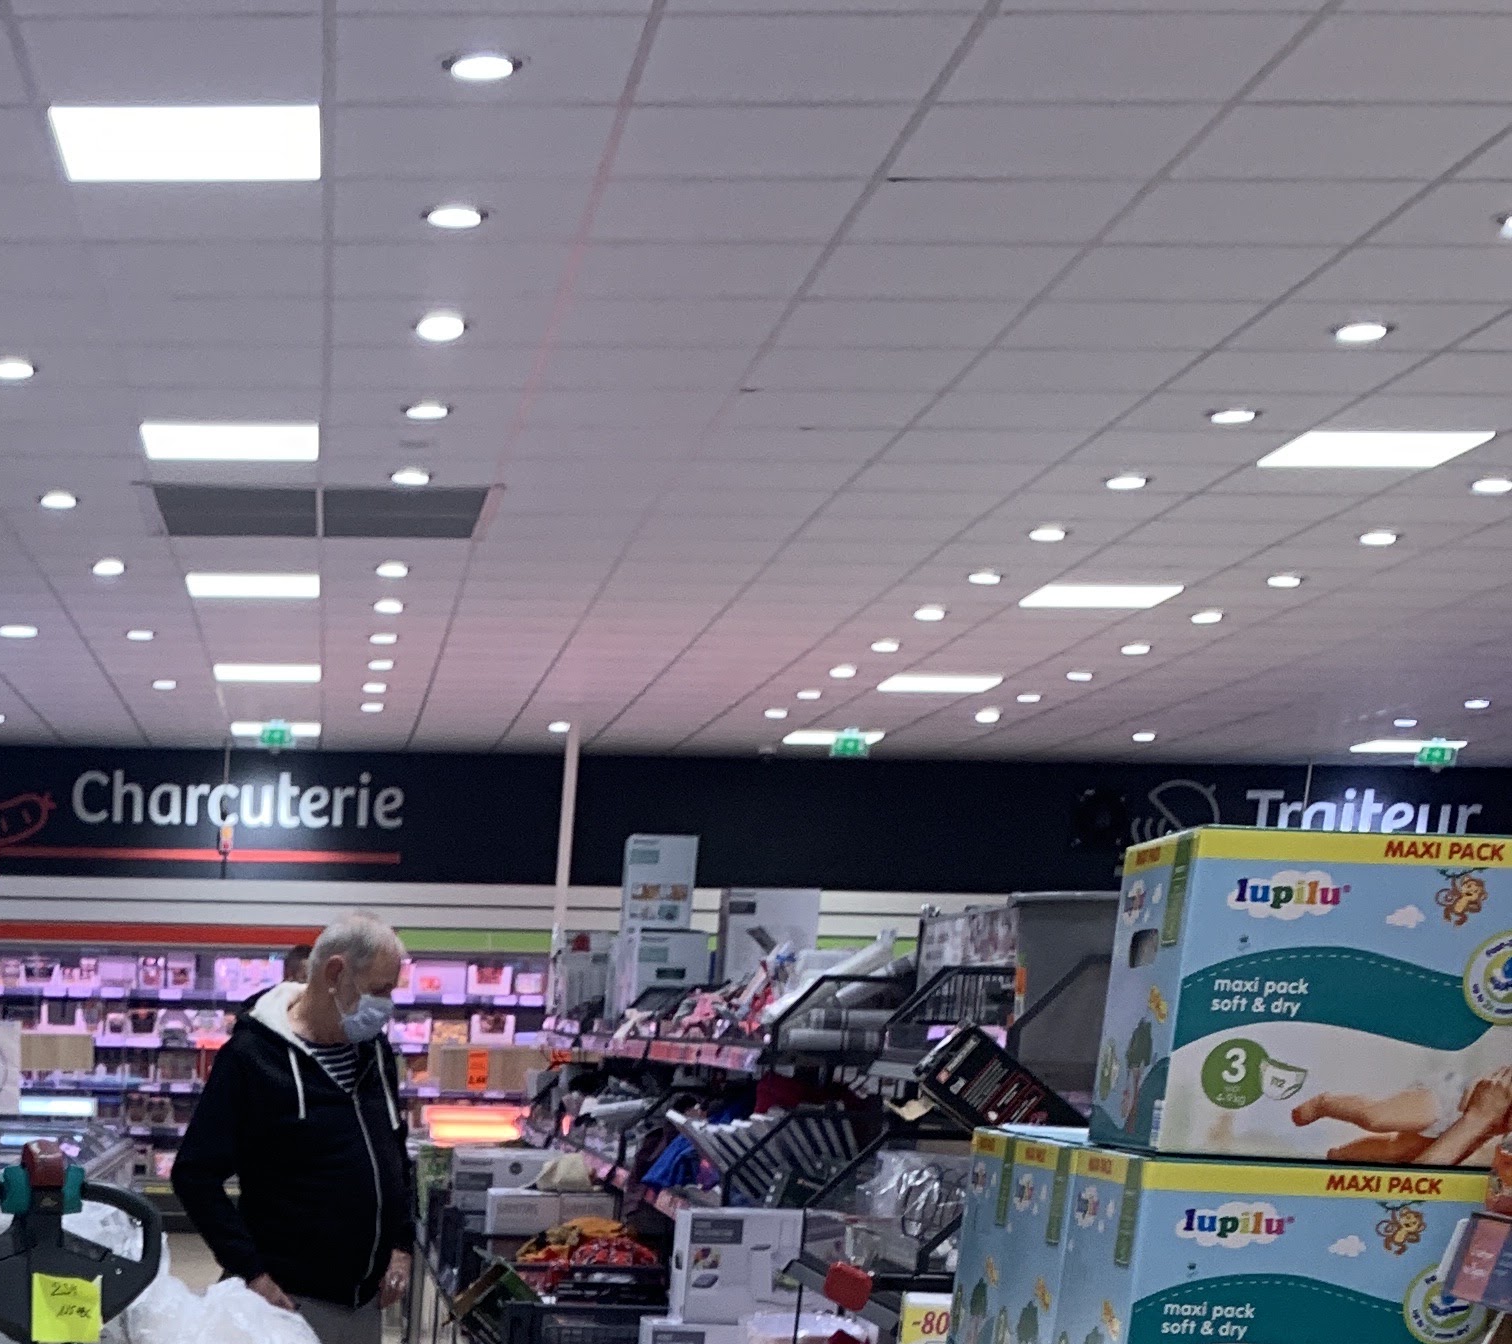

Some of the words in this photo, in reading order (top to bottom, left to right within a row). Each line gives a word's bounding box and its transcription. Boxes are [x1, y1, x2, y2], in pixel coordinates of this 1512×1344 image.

[71, 769, 404, 829] Charcuterie
[1246, 787, 1483, 833] Traiteur
[1384, 840, 1441, 860] MAXI
[1448, 842, 1506, 862] PACK
[1236, 878, 1342, 909] lupilu
[1214, 977, 1261, 993] maxi
[1264, 977, 1309, 997] pack
[1211, 997, 1248, 1012] soft
[1251, 998, 1267, 1013] &
[1270, 999, 1301, 1018] dry
[1221, 1048, 1247, 1083] 3
[1326, 1175, 1381, 1192] MAXI
[1389, 1176, 1443, 1194] PACK
[1183, 1208, 1285, 1238] lupilu
[1164, 1301, 1207, 1317] maxi
[1211, 1303, 1256, 1321] pack
[1160, 1320, 1196, 1335] soft
[1200, 1322, 1214, 1336] &
[1218, 1321, 1248, 1340] dry
